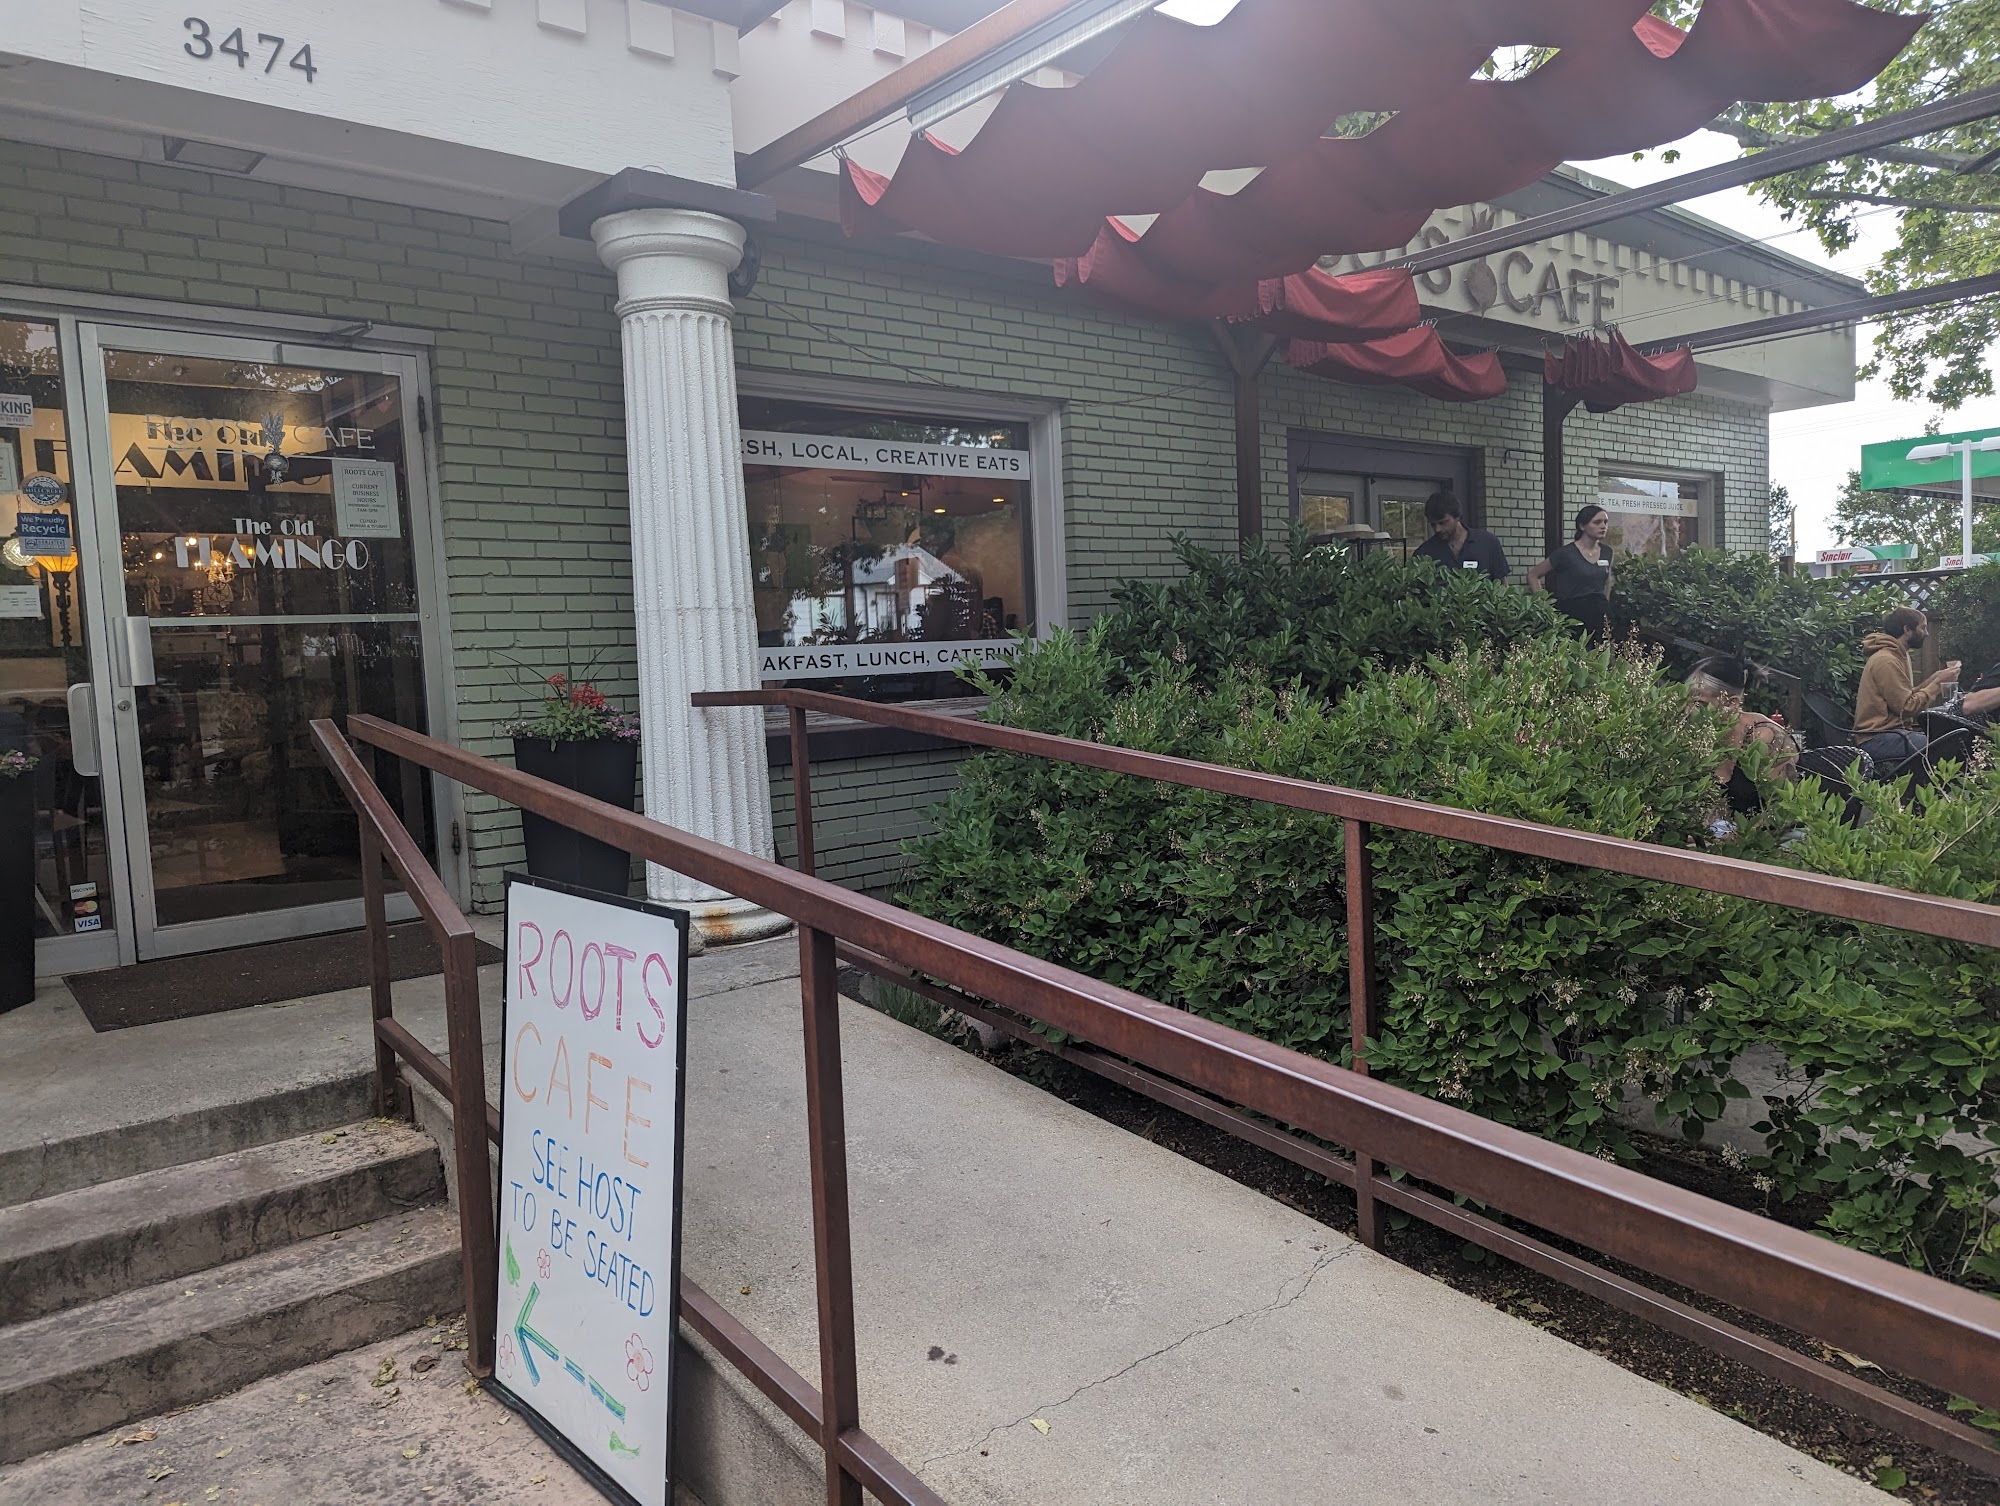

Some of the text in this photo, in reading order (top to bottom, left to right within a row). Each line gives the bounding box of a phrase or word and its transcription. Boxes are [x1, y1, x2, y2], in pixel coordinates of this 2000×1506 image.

[183, 17, 318, 83] 3474
[1503, 251, 1620, 330] CAFE
[293, 425, 376, 449] CAFE
[740, 439, 1020, 471] SH, LOCAL, CREATIVE EATS
[344, 468, 384, 477] ROOTS CAFE
[1622, 500, 1640, 508] FRESH
[21, 523, 66, 536] Recycle
[35, 517, 65, 525] Proudly
[232, 518, 314, 535] The Old
[174, 536, 369, 570] FLAMINGO
[1820, 551, 1852, 562] Sinclair
[1944, 556, 1963, 567] Sincl
[758, 653, 848, 672] AKFAST,
[857, 650, 931, 667] LUNCH,
[77, 919, 99, 927] VISA
[519, 921, 673, 1049] ROOTS
[513, 1021, 652, 1169] CAFE
[532, 1129, 641, 1242] SEE HOST
[510, 1181, 655, 1317] TO BE SEATED
